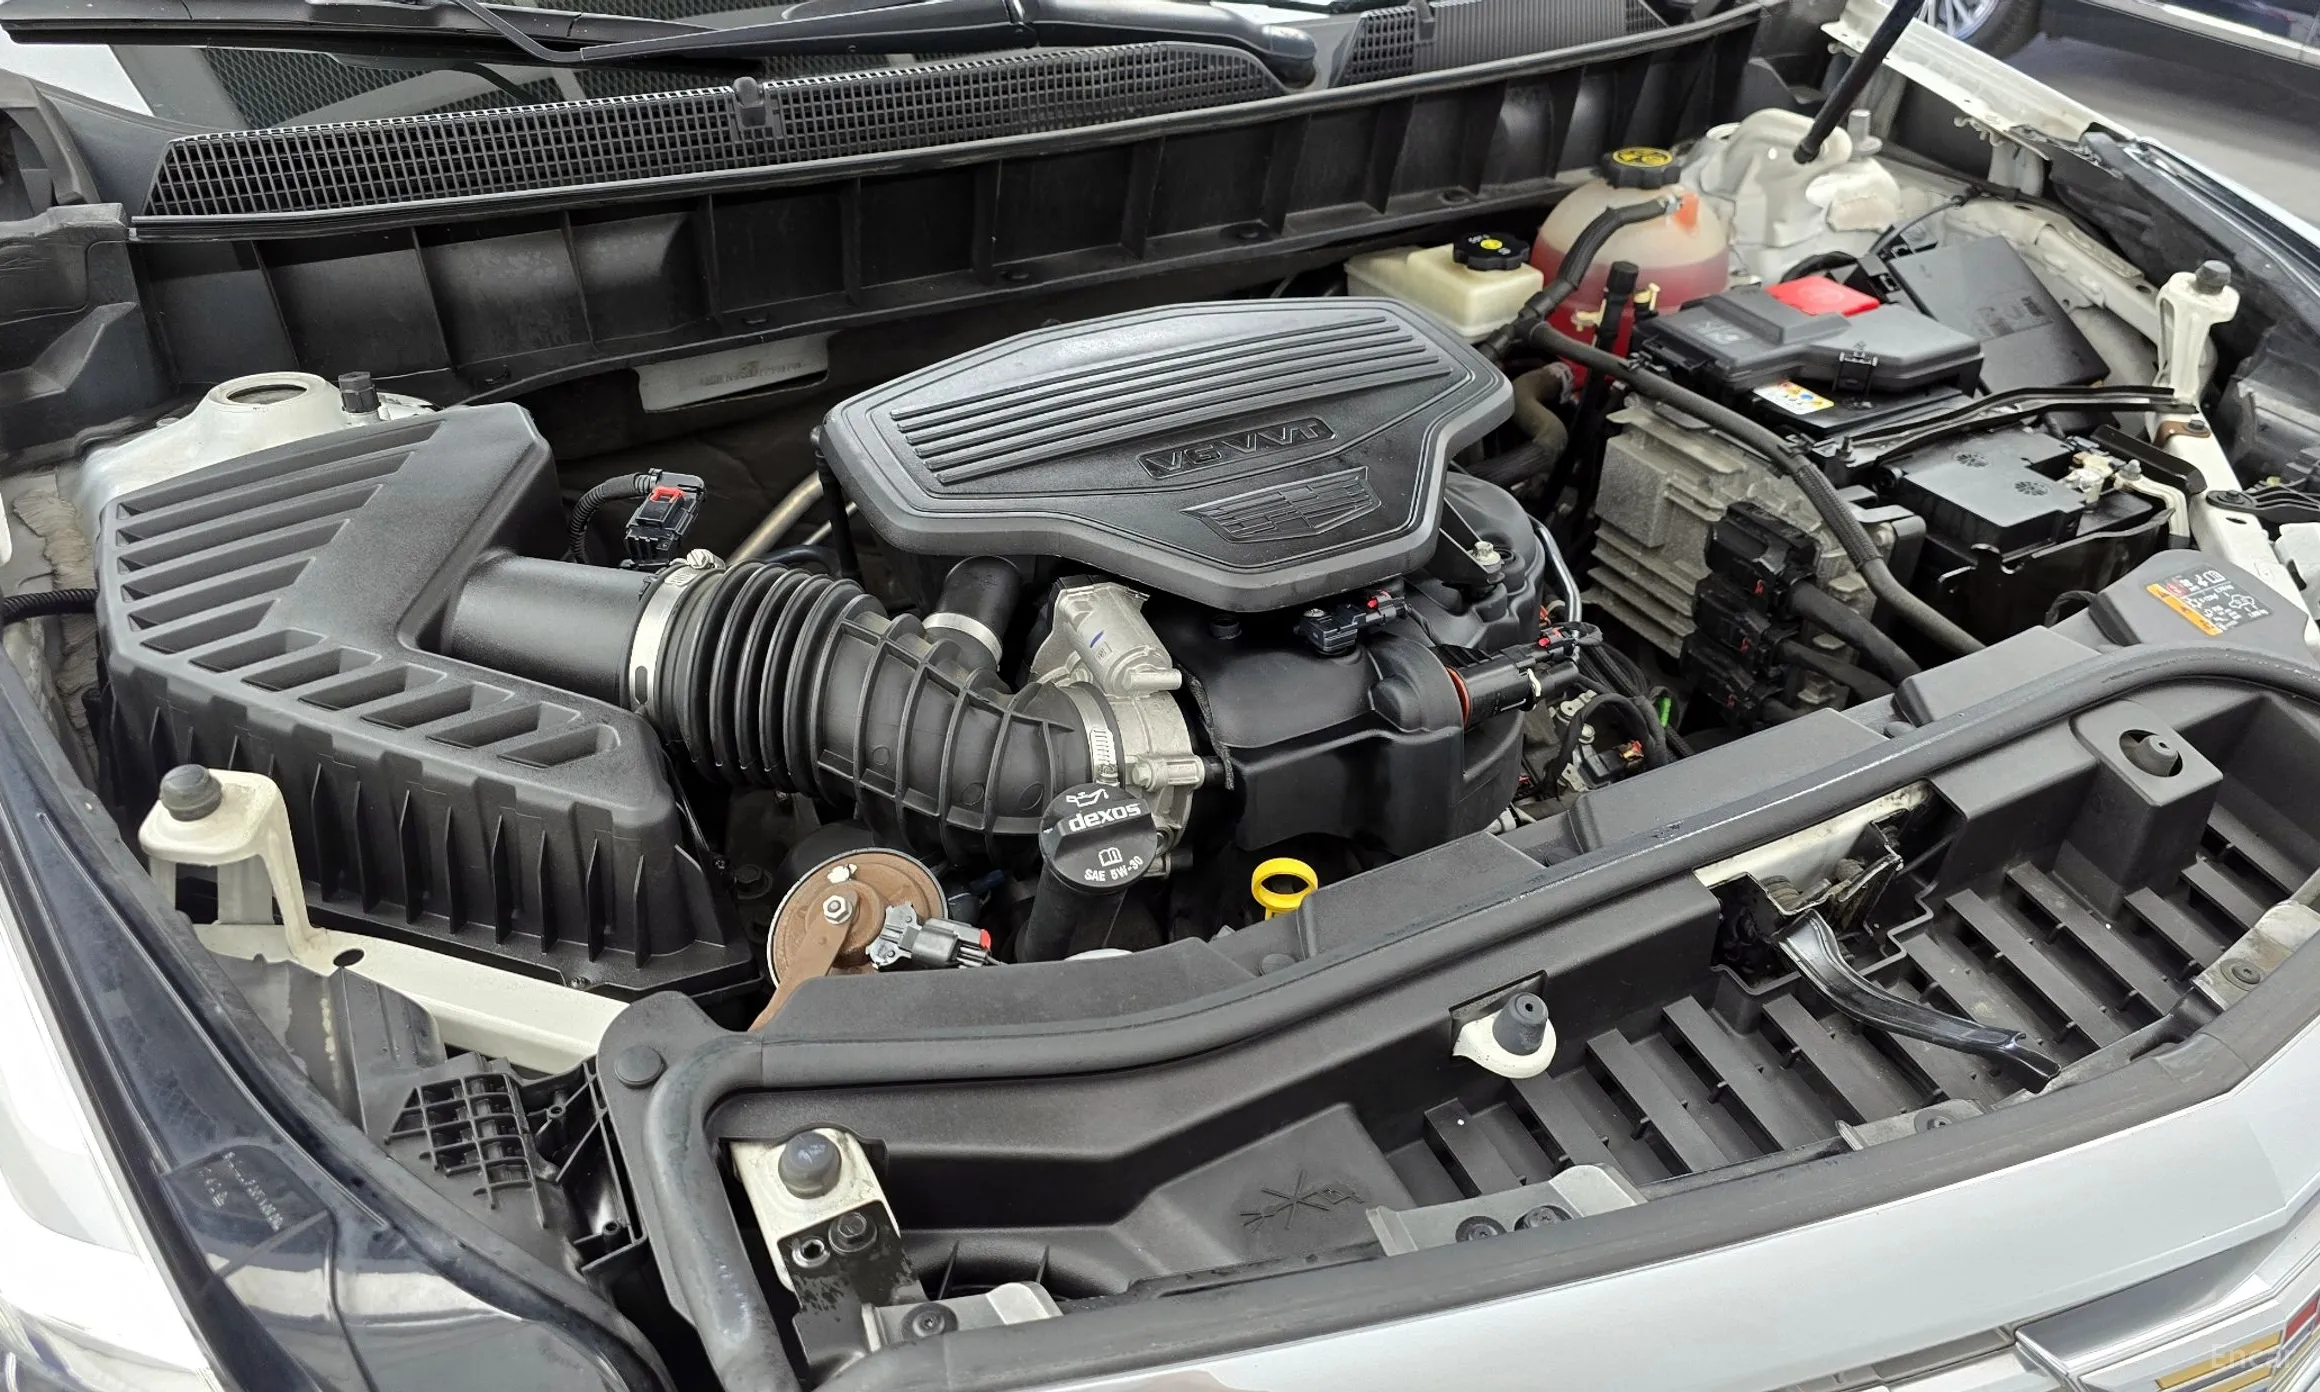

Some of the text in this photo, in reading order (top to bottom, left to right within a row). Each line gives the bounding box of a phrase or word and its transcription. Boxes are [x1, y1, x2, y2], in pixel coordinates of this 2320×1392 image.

[1146, 422, 1319, 472] V6 VVT
[1068, 803, 1142, 832] dexos
[1084, 856, 1144, 882] SAE 5W-30
